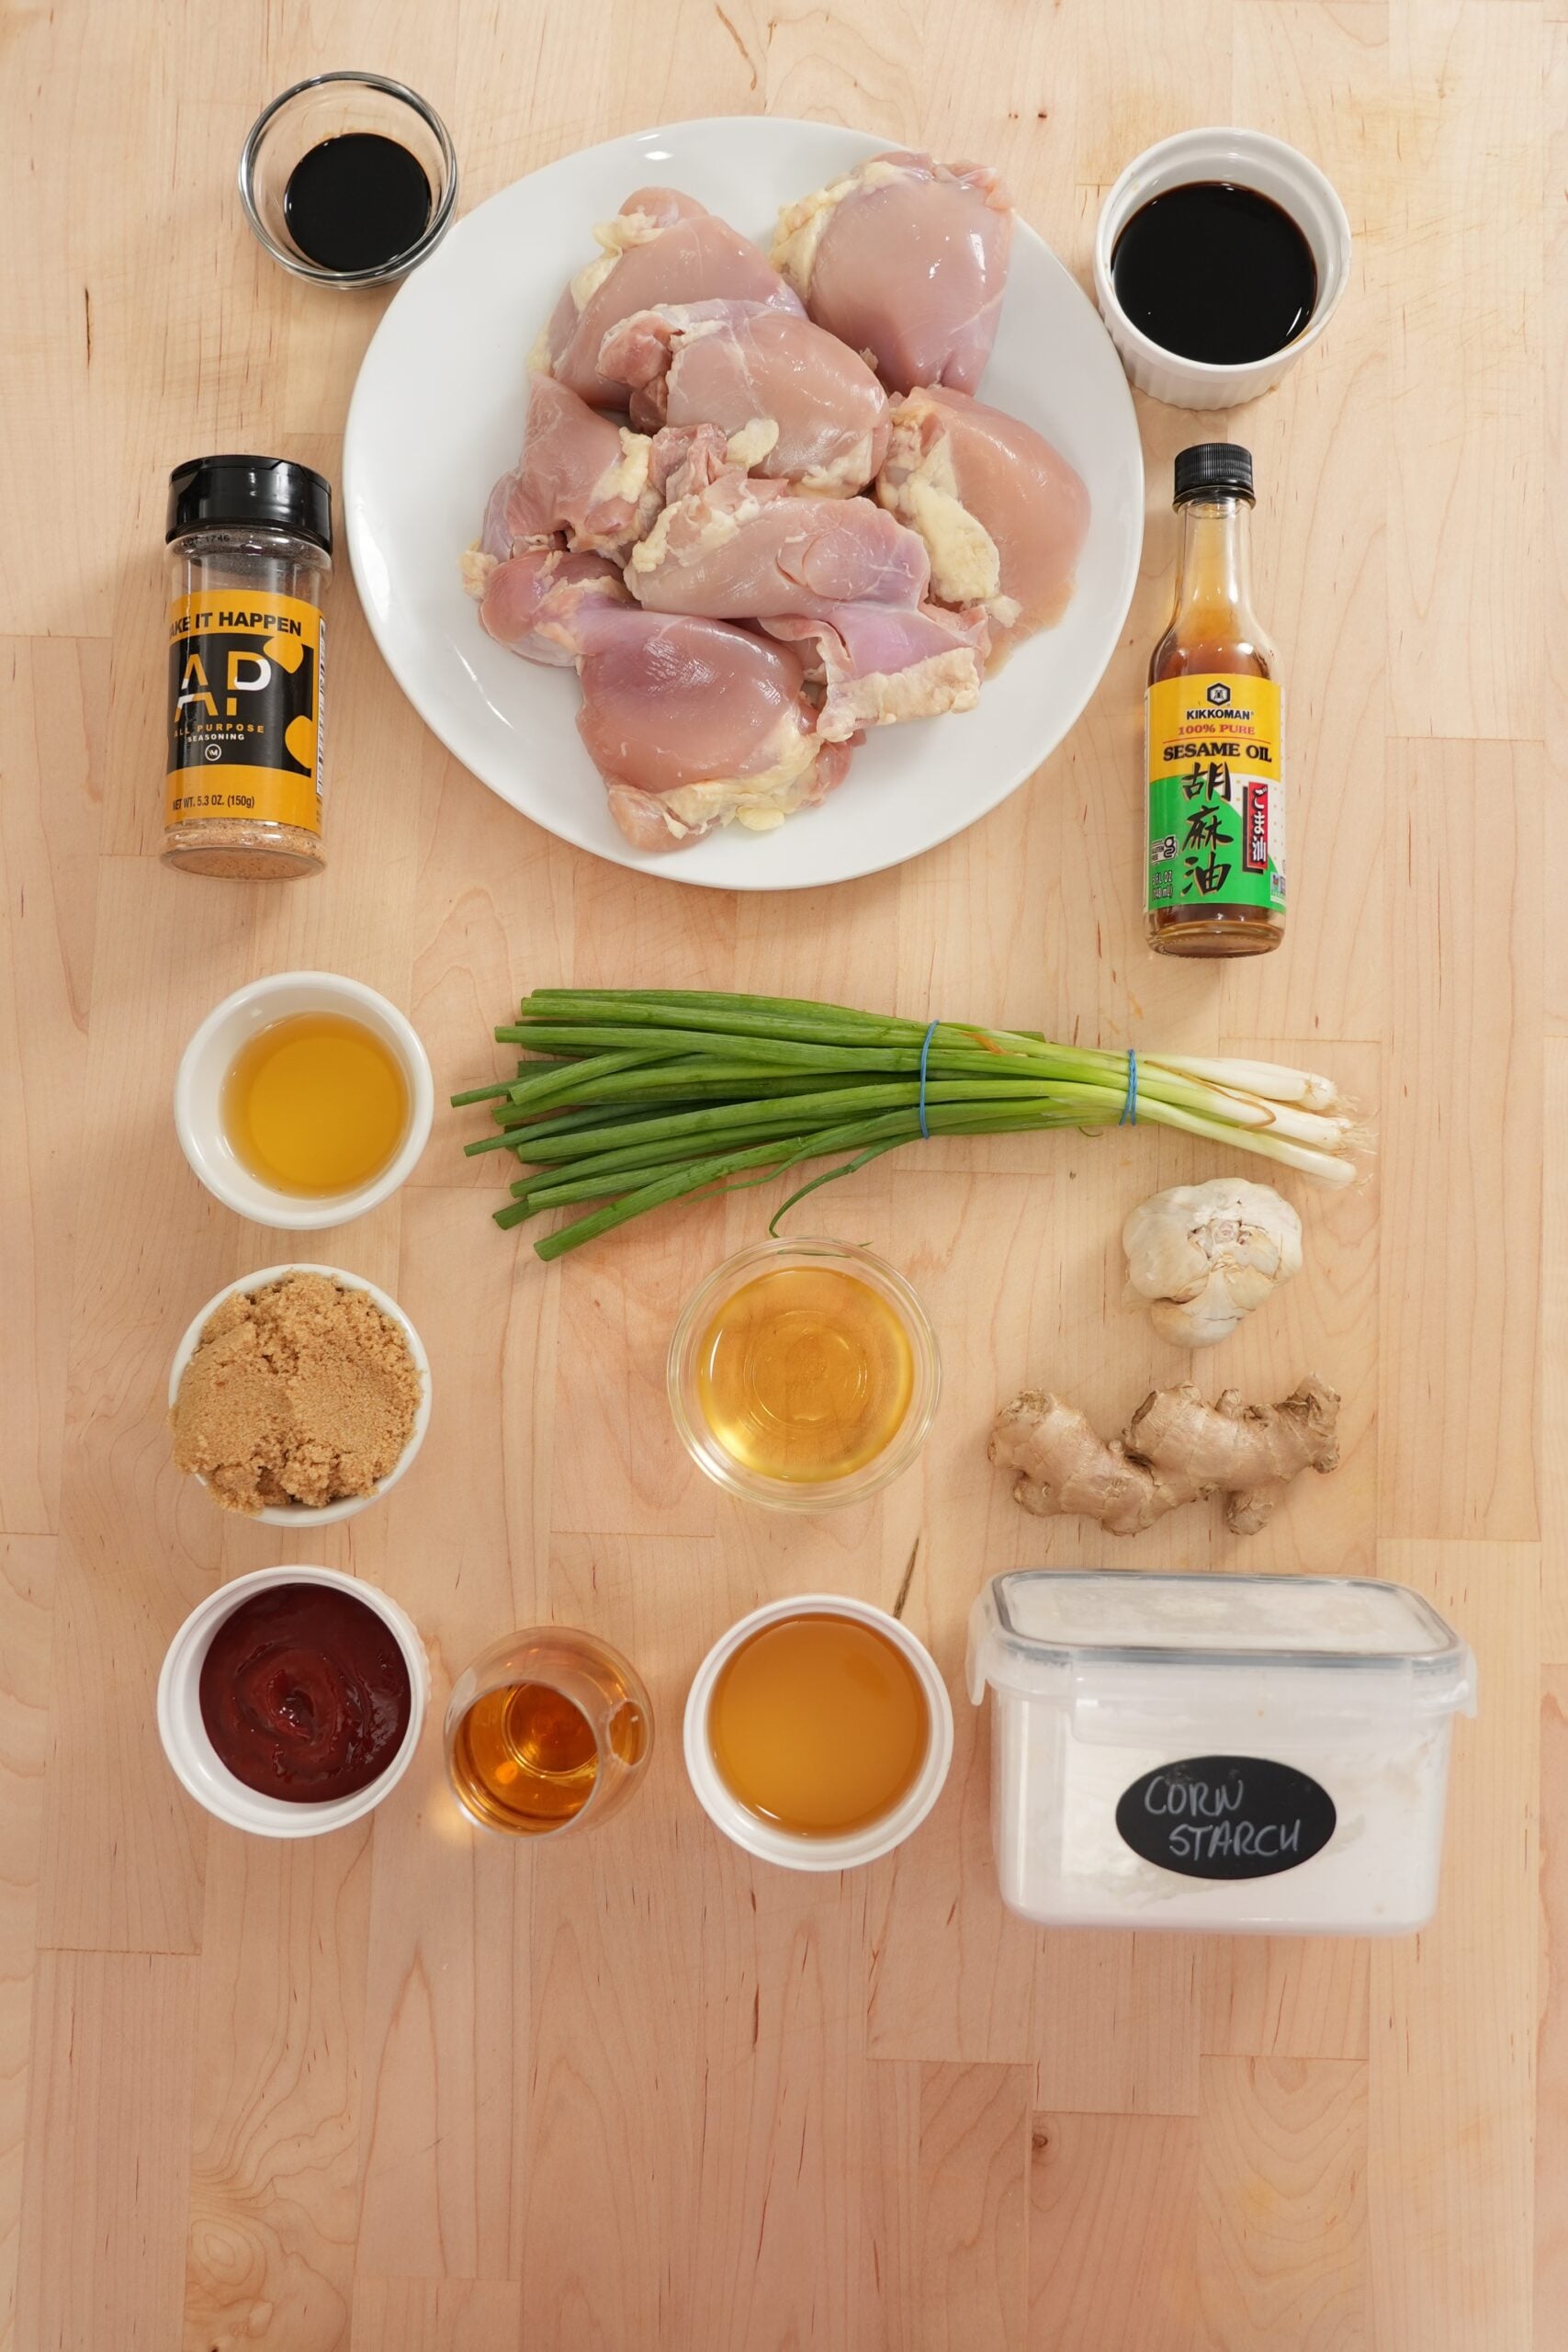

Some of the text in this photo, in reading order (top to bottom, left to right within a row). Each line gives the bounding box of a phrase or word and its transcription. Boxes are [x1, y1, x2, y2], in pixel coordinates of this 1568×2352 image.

[205, 534, 230, 543] 1746
[169, 612, 301, 639] AKE IT HAPPEN
[175, 650, 271, 723] AP
[1186, 708, 1250, 720] KIKKOMAN
[174, 723, 265, 738] ALL PURPOSE
[187, 733, 245, 742] SEASONING
[1178, 724, 1255, 735] 100% PURE
[1163, 742, 1272, 763] SESAME OIL
[173, 795, 254, 810] NET WT. 5.3 OZ. (150g)
[1181, 761, 1234, 895] 胡麻油
[1251, 786, 1268, 864] ごま油
[1164, 870, 1172, 883] OZ
[1144, 1774, 1244, 1816] CORN
[1168, 1819, 1302, 1861] STARCH
